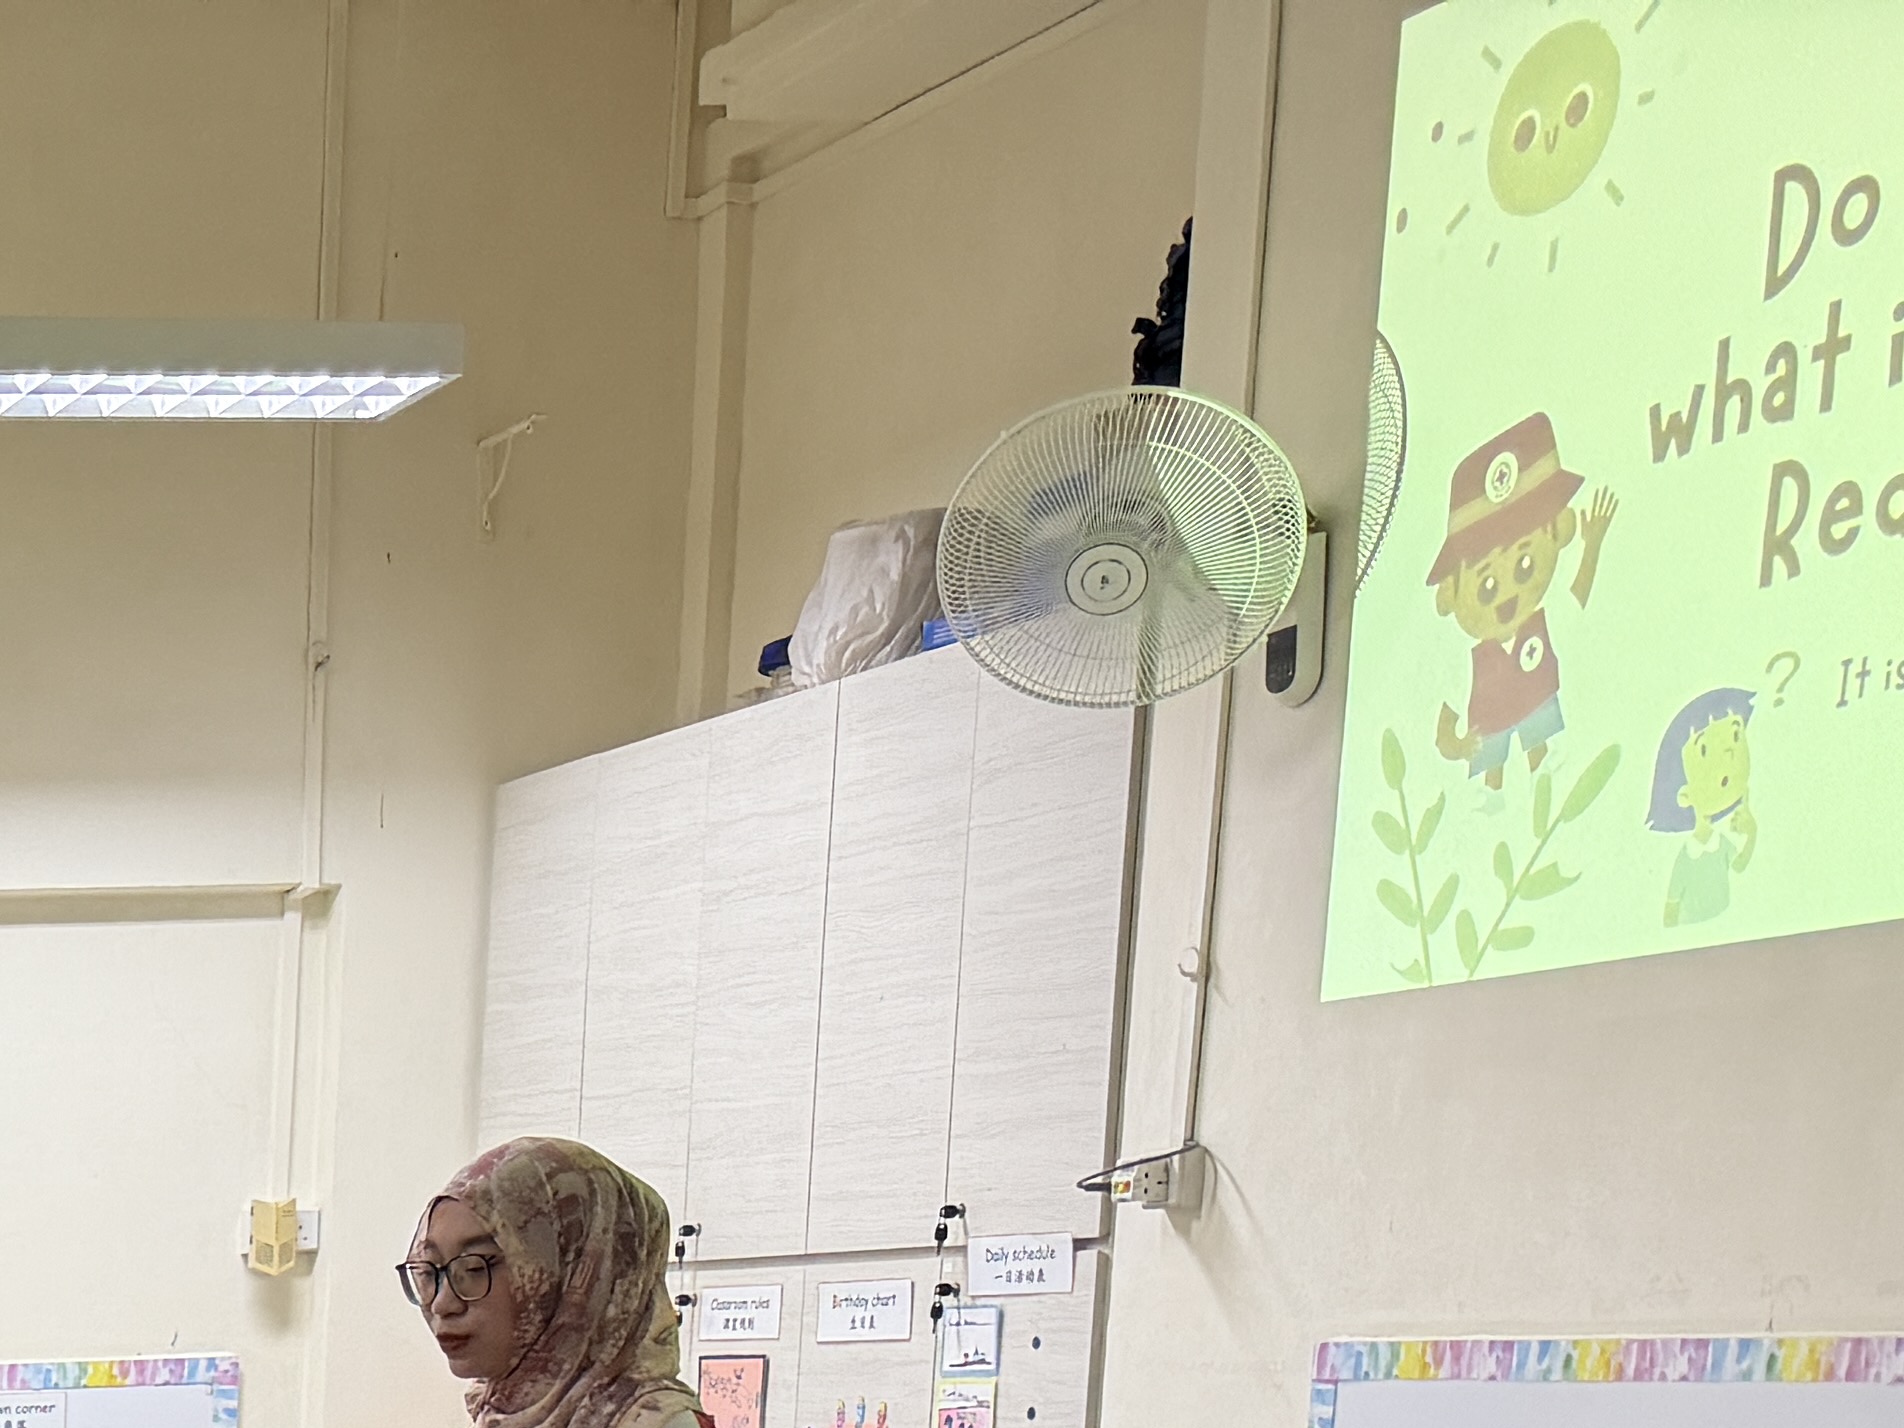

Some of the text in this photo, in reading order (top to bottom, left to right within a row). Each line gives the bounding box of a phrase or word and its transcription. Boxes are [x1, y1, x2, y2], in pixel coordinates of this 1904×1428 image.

[1763, 163, 1881, 302] Do
[1649, 299, 1852, 463] what
[1837, 656, 1870, 709] It
[985, 1245, 1057, 1264] Daily schedule
[832, 1293, 897, 1311] Birthday chart
[15, 1403, 56, 1415] corner
